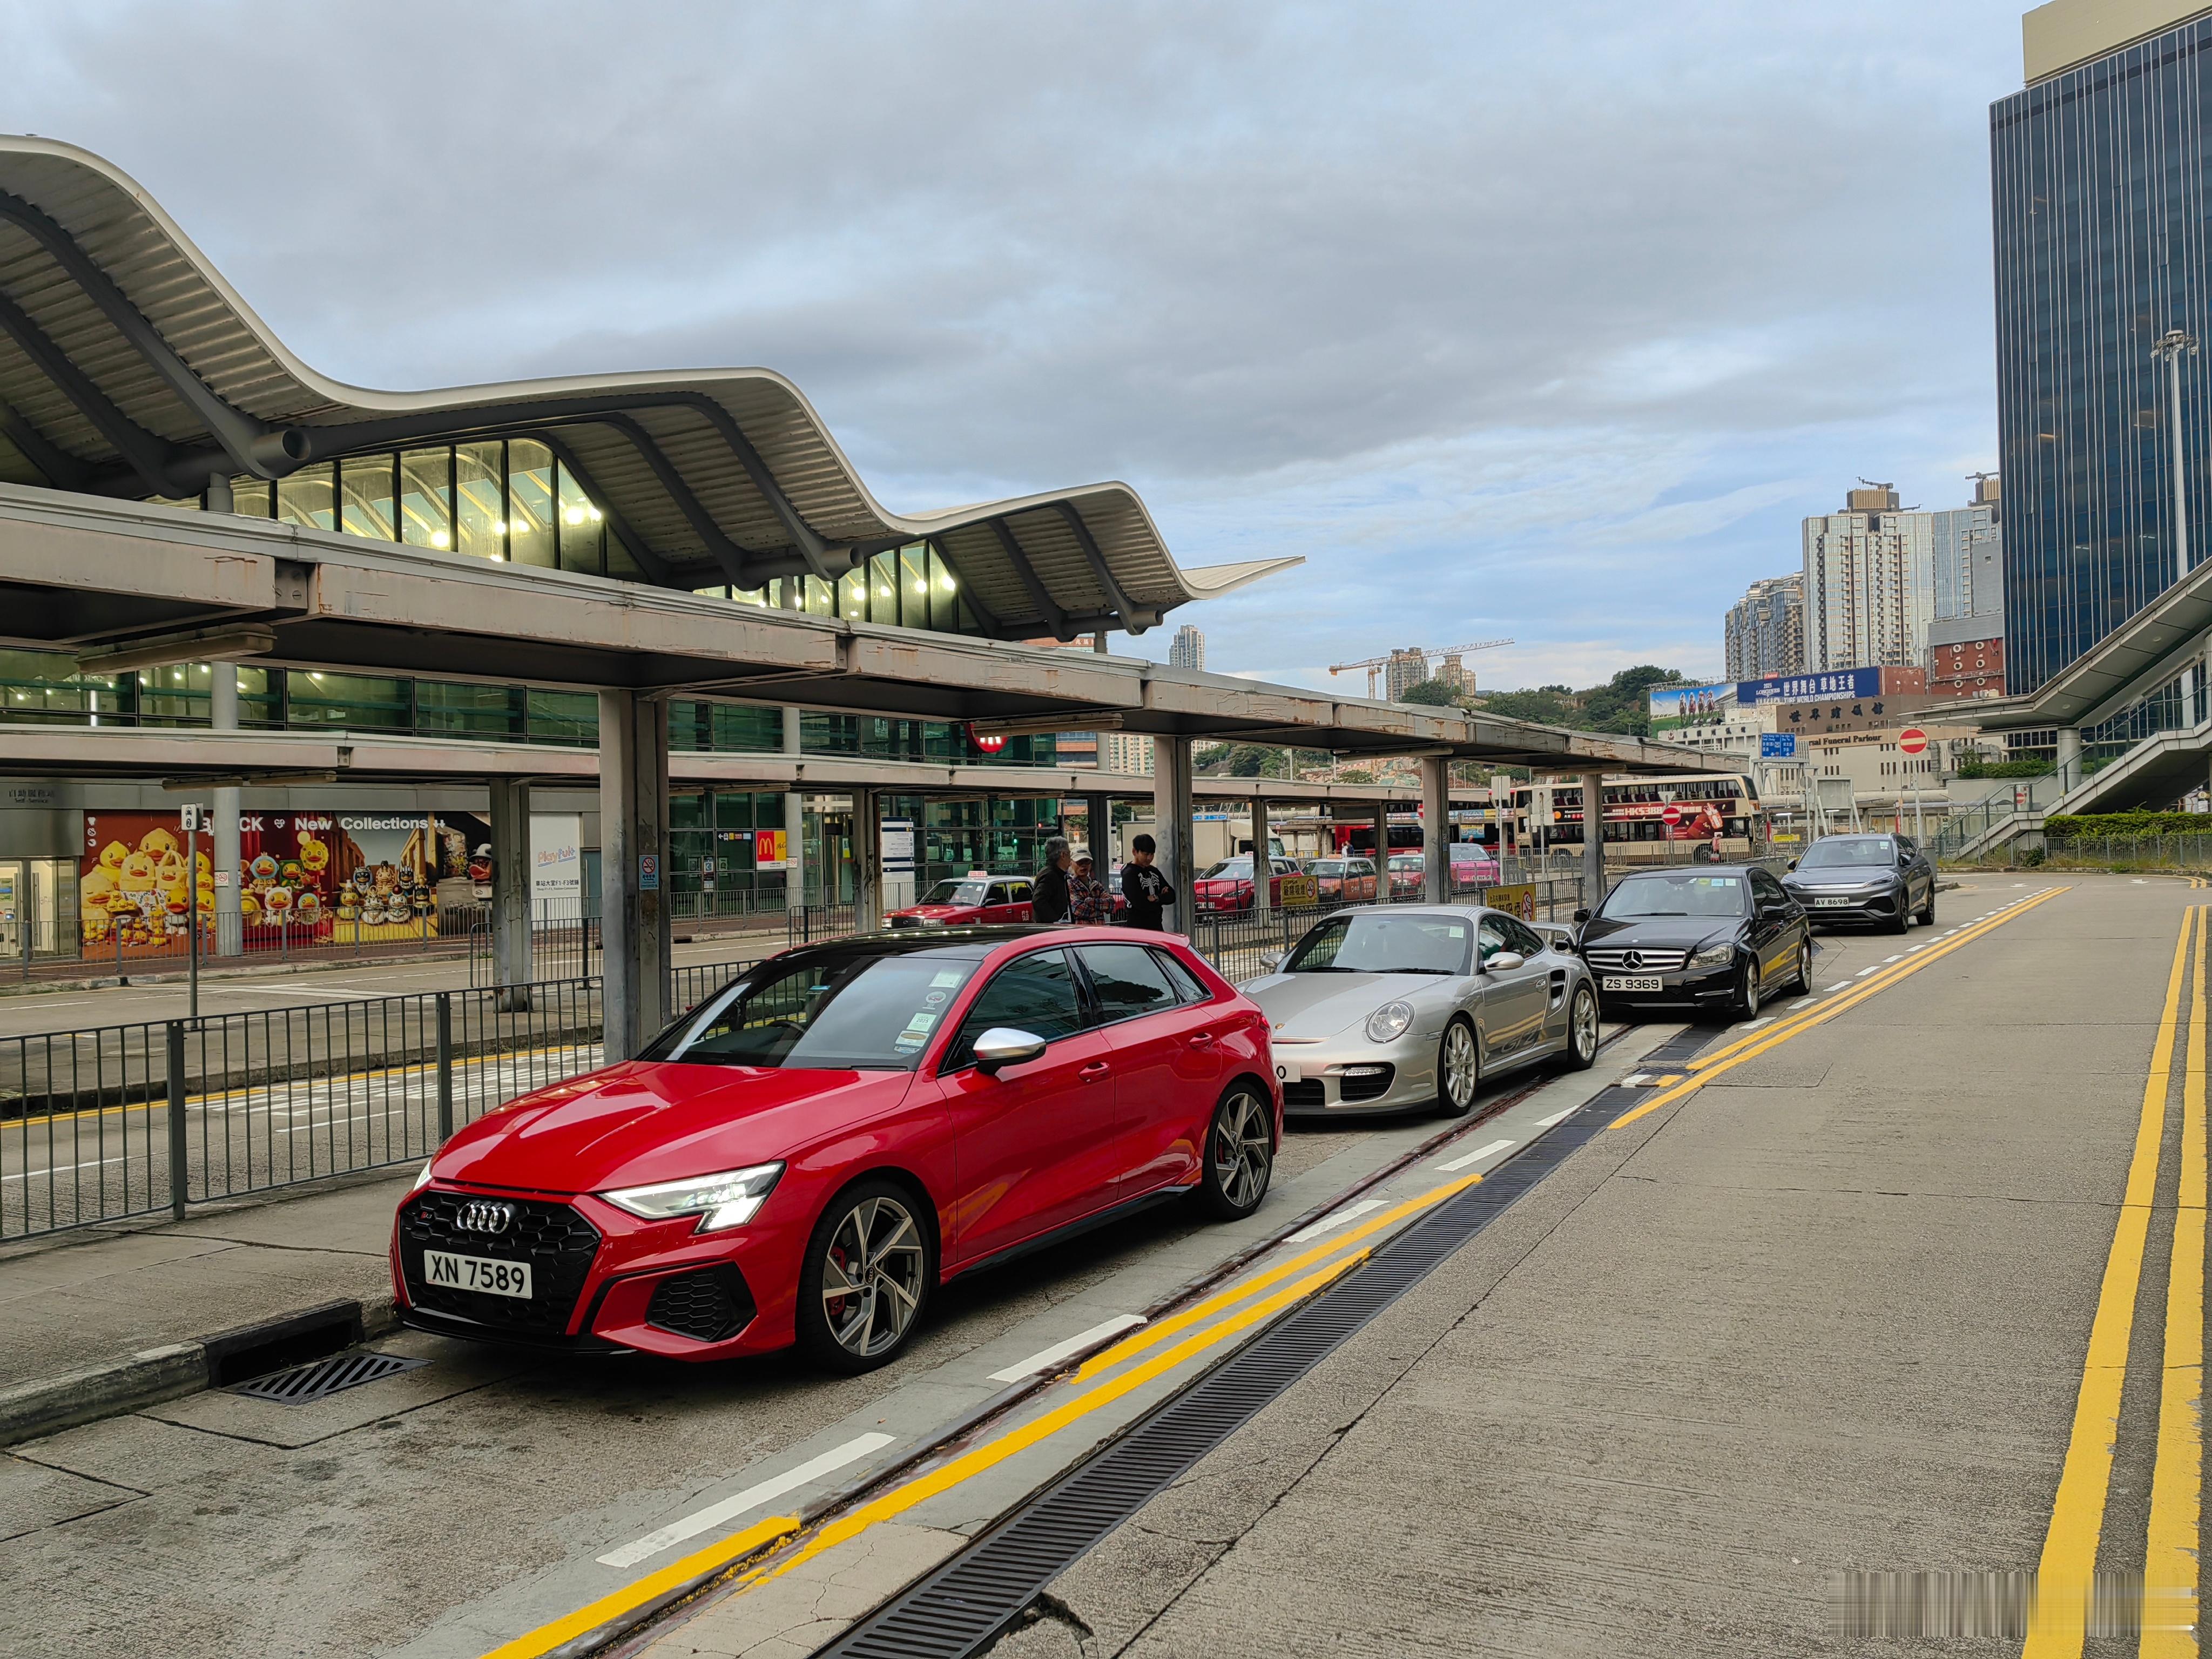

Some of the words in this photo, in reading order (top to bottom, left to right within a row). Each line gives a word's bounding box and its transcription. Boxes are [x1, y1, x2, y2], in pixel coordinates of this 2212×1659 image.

[1784, 679, 1816, 696] 世界舞台
[1820, 674, 1854, 692] 草地王者
[1797, 694, 1814, 703] WORLD
[1815, 690, 1856, 702] CHAMPIONSHIPS
[1823, 736, 1851, 745] Funeral
[1853, 734, 1883, 743] Parlour
[295, 818, 333, 831] New
[340, 817, 429, 830] Collections
[1606, 979, 1621, 988] ZS
[1626, 979, 1659, 989] 9369
[431, 1255, 459, 1284] XN
[464, 1260, 525, 1293] 7589
